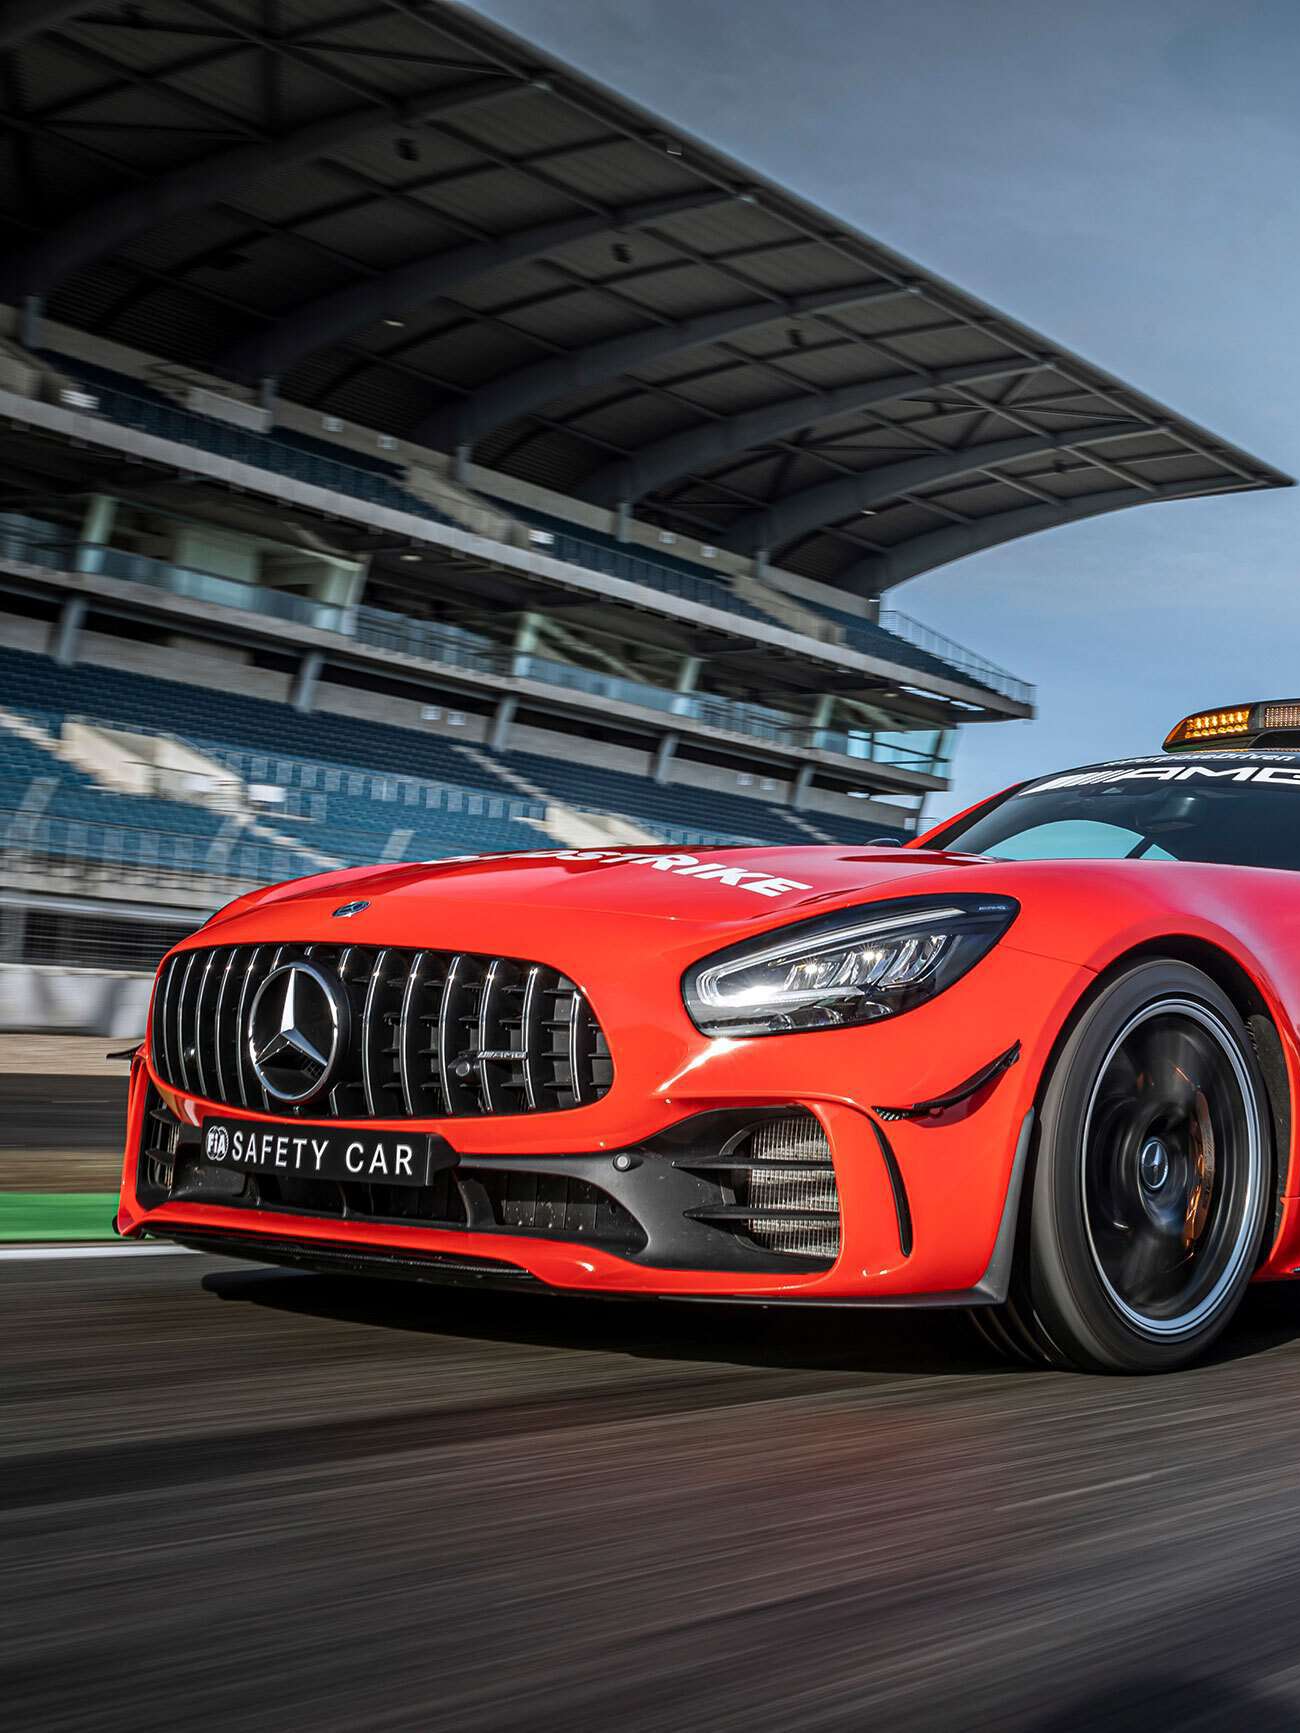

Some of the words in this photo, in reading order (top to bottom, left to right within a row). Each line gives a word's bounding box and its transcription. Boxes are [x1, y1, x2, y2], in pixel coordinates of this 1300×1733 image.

[208, 1134, 226, 1153] FIA
[232, 1130, 330, 1171] SAFETY
[345, 1142, 413, 1175] CAR
